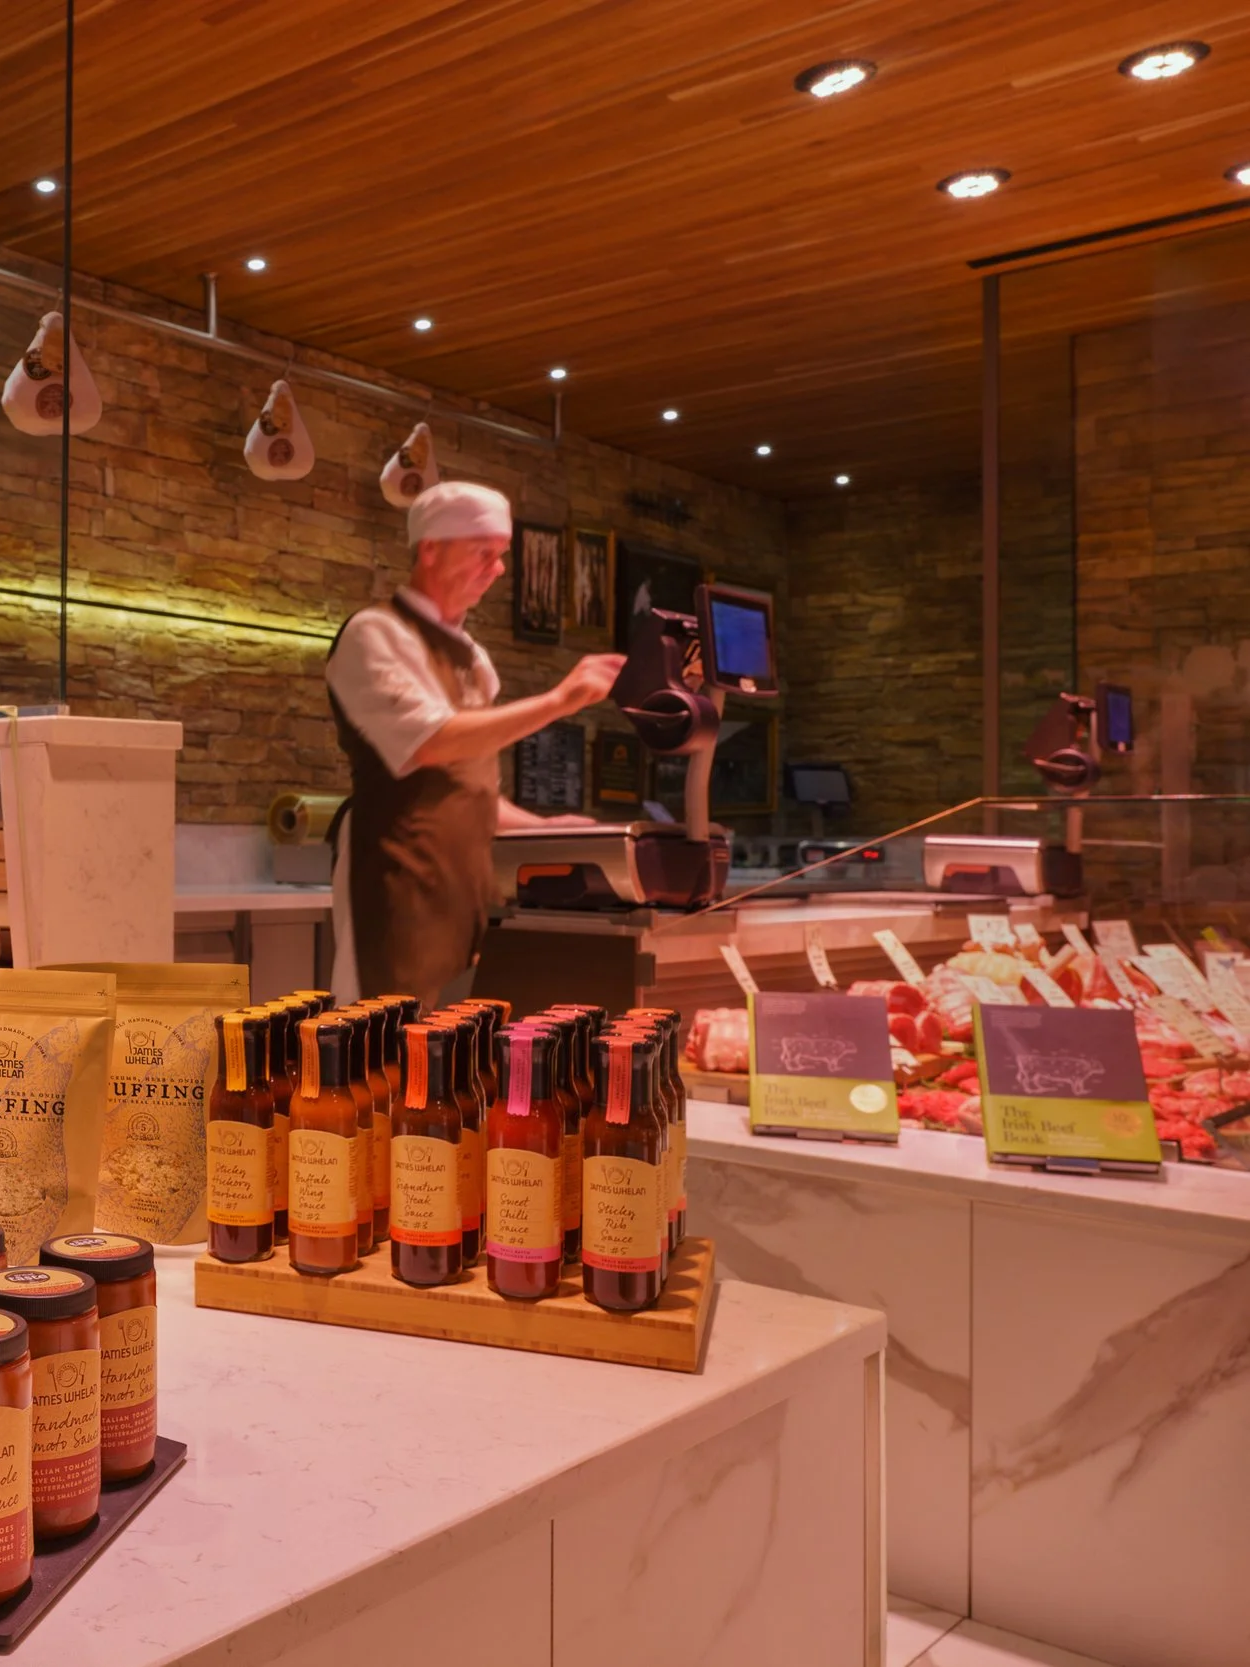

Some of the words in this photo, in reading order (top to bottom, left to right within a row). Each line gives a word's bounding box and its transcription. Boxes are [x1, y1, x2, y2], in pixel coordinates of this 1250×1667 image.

[133, 1047, 163, 1056] JAMES
[125, 1056, 163, 1065] WHELAN
[109, 1083, 204, 1100] UFFING
[610, 1246, 626, 1255] #5
[33, 1393, 62, 1406] AMES
